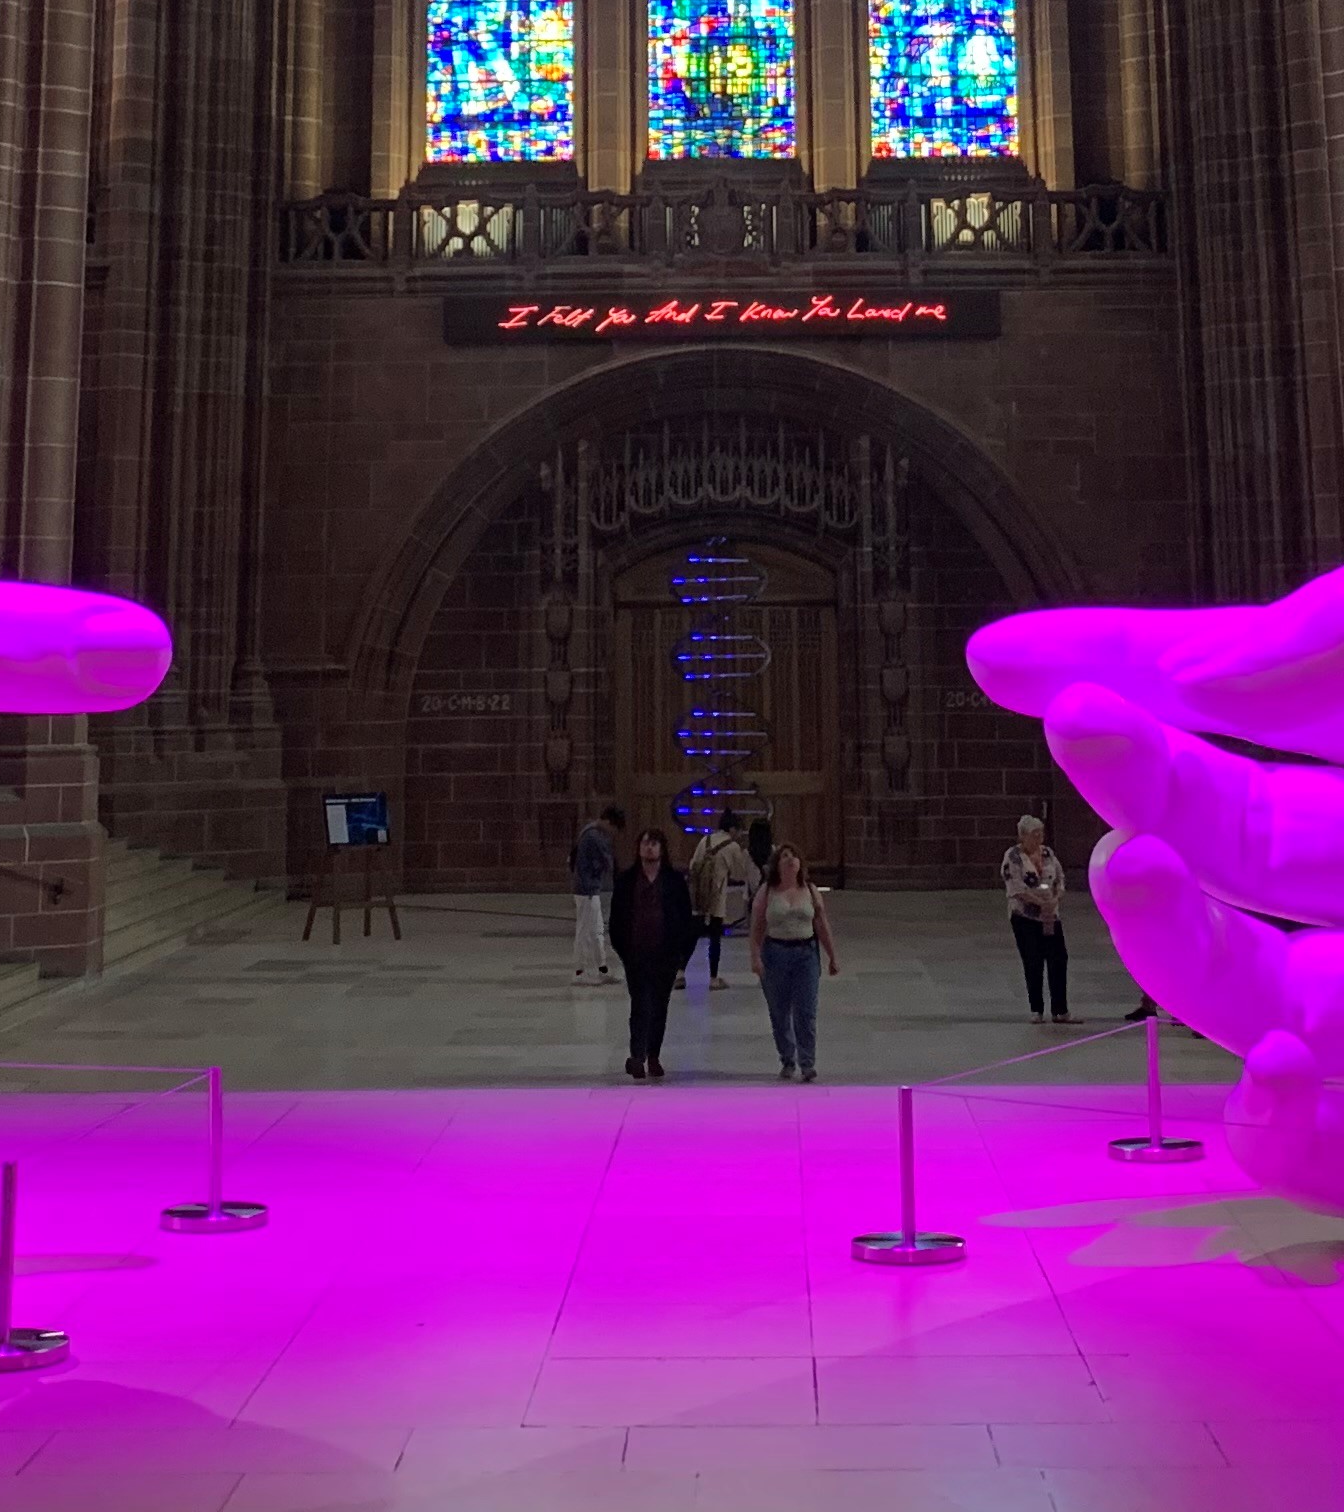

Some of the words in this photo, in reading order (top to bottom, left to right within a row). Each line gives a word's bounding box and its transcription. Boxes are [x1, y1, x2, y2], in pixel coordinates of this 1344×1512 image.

[498, 305, 539, 329] I
[537, 306, 595, 328] Felt
[644, 300, 700, 324] And
[704, 301, 739, 320] I
[801, 295, 841, 322] You
[846, 298, 913, 322] Loved
